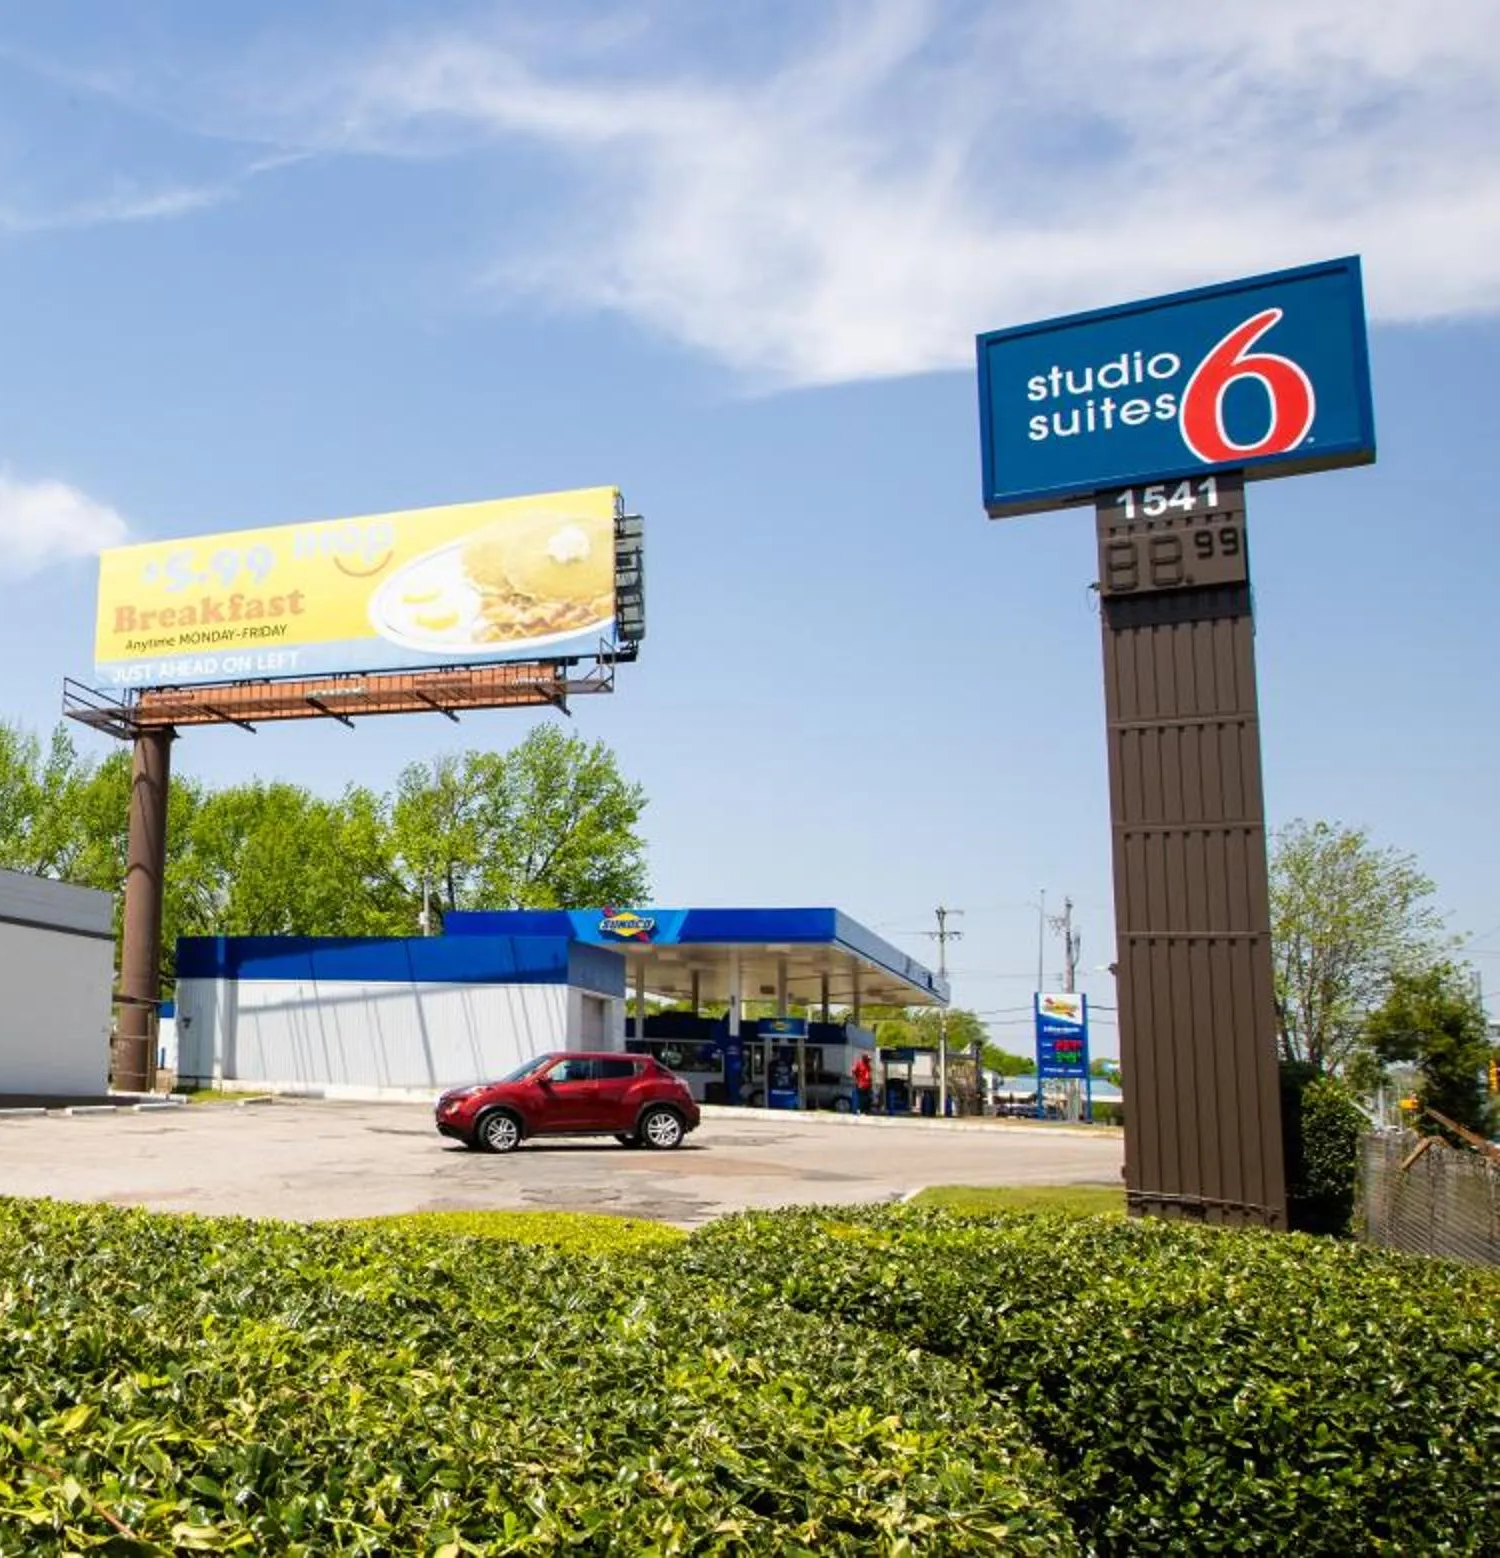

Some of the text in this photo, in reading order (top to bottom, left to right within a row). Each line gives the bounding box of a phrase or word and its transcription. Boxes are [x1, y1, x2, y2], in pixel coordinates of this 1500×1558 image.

[1026, 351, 1181, 402] studio
[1178, 306, 1316, 465] 6
[1027, 392, 1177, 441] suites
[1116, 476, 1219, 519] 1541
[111, 588, 306, 634] Breakfast
[124, 635, 177, 653] Anytime
[111, 651, 300, 684] JUST AHEAD ON LEFT
[598, 916, 655, 931] SUNOCO
